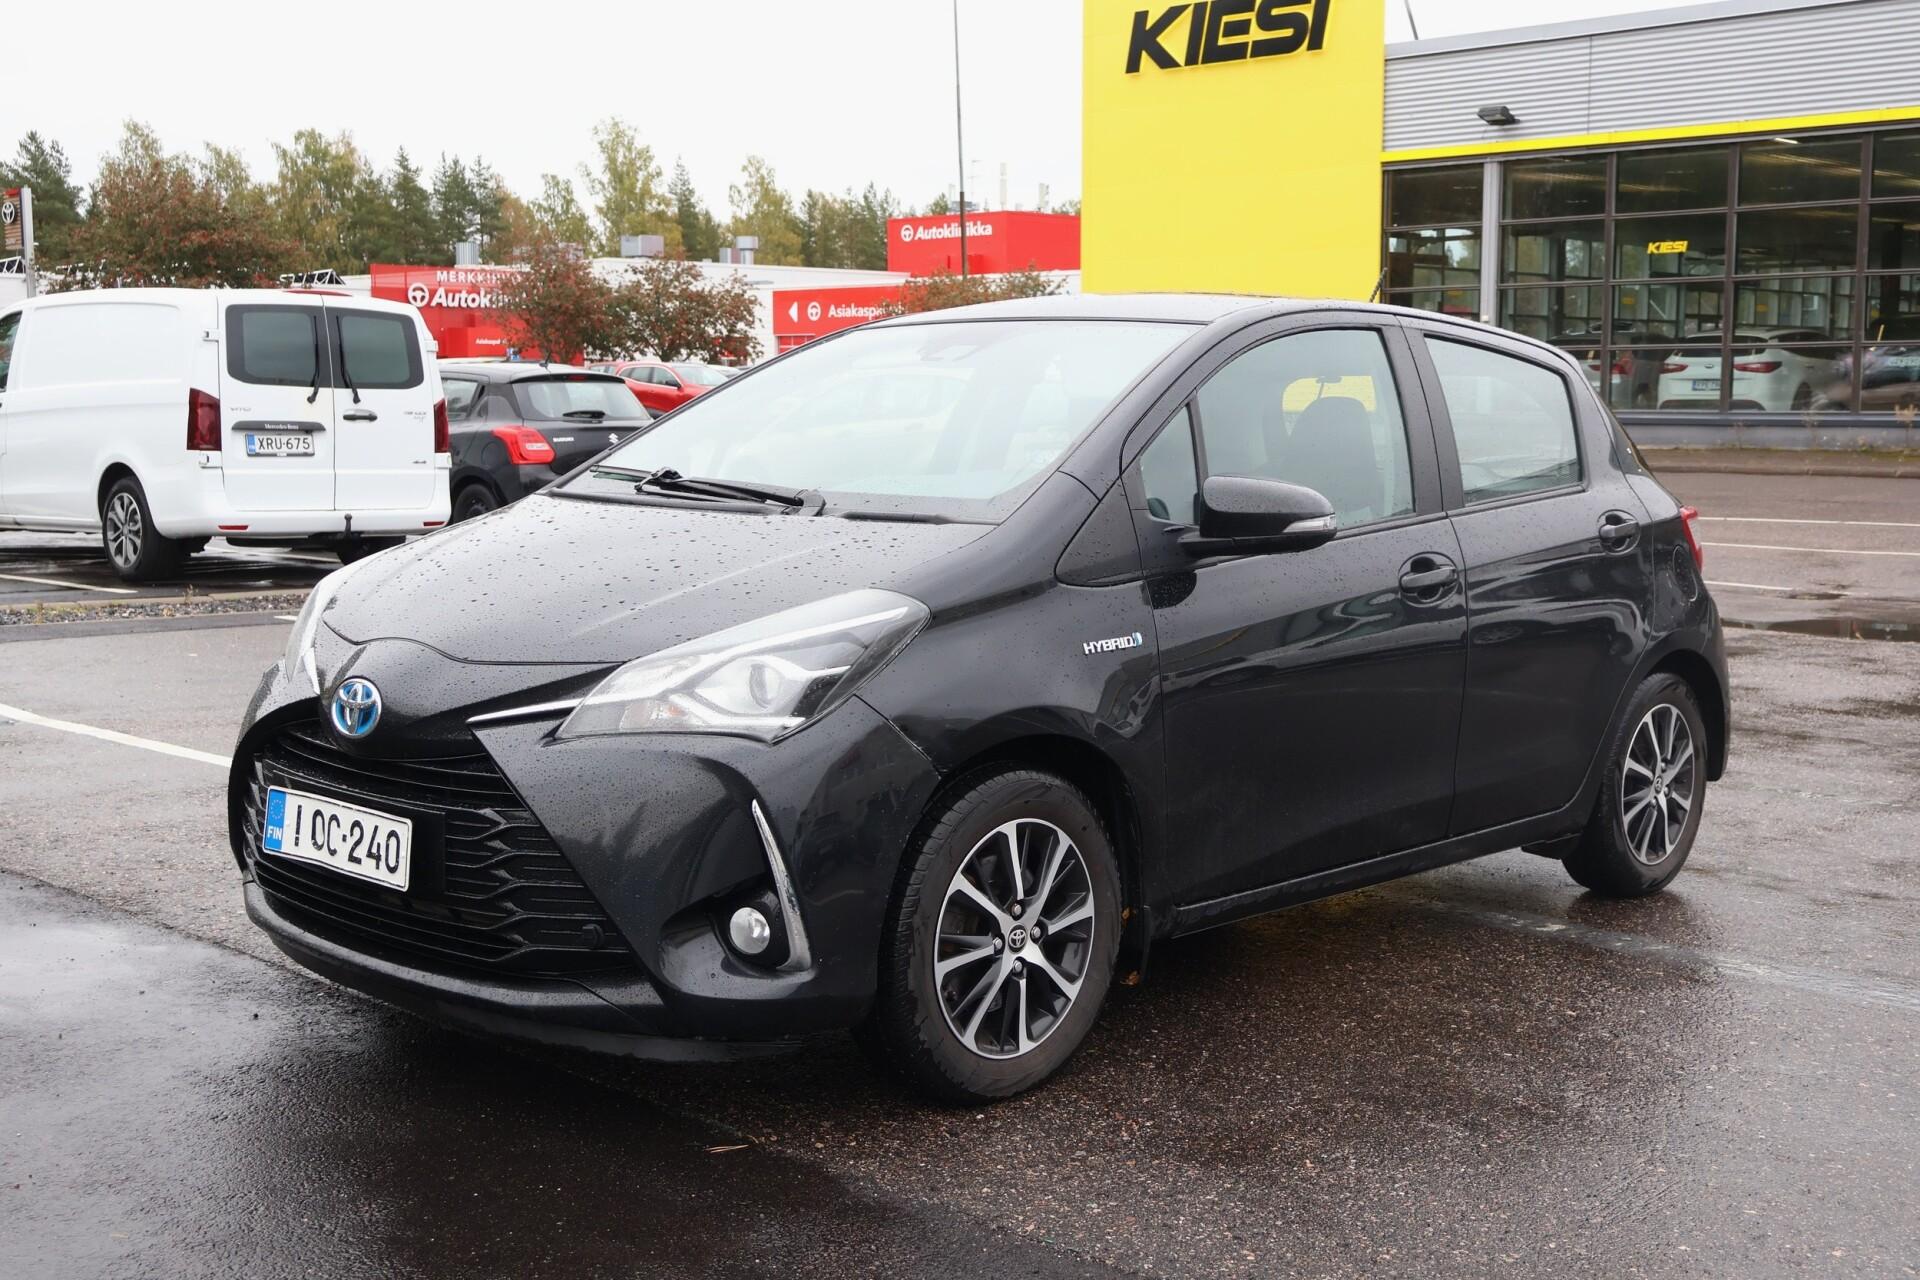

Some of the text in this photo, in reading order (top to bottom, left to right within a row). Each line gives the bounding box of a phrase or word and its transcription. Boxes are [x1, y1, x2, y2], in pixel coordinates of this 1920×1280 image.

[1125, 0, 1331, 74] KIESI
[1647, 240, 1688, 254] KIESI
[257, 437, 310, 450] XRU-675
[1083, 636, 1134, 655] HYBRID
[267, 825, 283, 841] FIN
